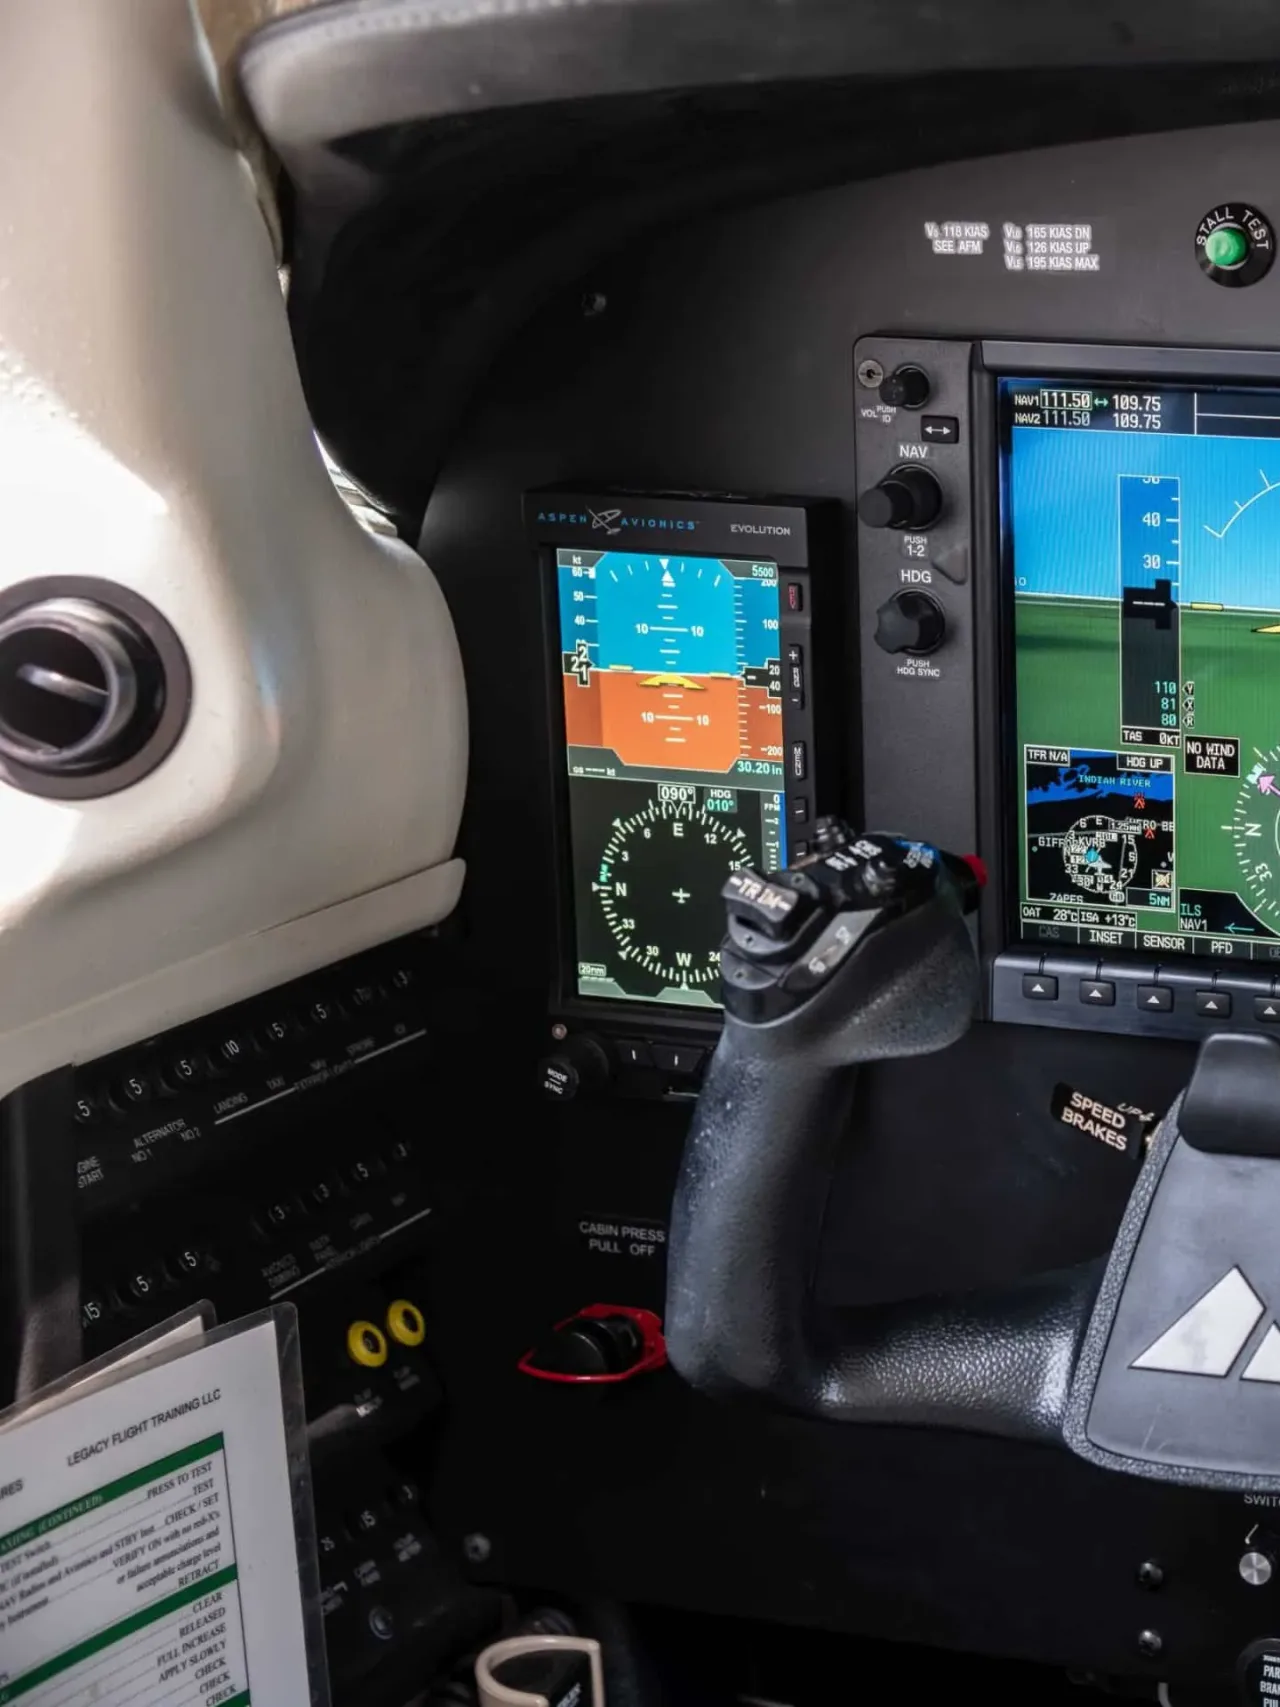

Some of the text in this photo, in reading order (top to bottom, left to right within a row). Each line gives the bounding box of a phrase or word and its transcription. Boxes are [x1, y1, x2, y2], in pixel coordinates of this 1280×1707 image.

[1029, 228, 1089, 238] 165 KIAS DN
[1196, 207, 1269, 249] STALL TEST
[935, 241, 980, 251] SEE AFM
[1030, 242, 1088, 252] 126 KIAS UP
[1030, 257, 1098, 268] 195 KIAS MAX
[1015, 390, 1161, 412] NAV1 111.50 109.75
[1015, 410, 1161, 429] NAV2 111.50 109.75
[900, 446, 928, 458] NAV
[538, 512, 695, 530] ASPEN AVIONICS
[731, 524, 790, 536] EVOLUTION
[907, 545, 925, 557] 1-2
[752, 566, 773, 577] 5500
[901, 570, 931, 583] HDG
[1187, 740, 1234, 756] NO WIND
[1029, 749, 1068, 762] TFR N/A
[737, 761, 769, 773] 30.20
[1127, 758, 1162, 768] HDG UP
[1196, 756, 1225, 770] DATA
[710, 790, 731, 798] HDG
[1181, 903, 1201, 915] ILS
[1180, 918, 1207, 931] NAV1
[1090, 931, 1123, 945] INSET
[1144, 936, 1185, 950] SENSOR
[1212, 942, 1233, 954] PFD
[1070, 1092, 1125, 1128] SPEED
[1061, 1106, 1127, 1150] BRAKES
[580, 1222, 665, 1242] CABIN PRESS
[589, 1239, 655, 1256] PULL OFF
[67, 1389, 221, 1467] LEGACY FLIGHT TRAINING LLC
[178, 1607, 226, 1638] RELEASED
